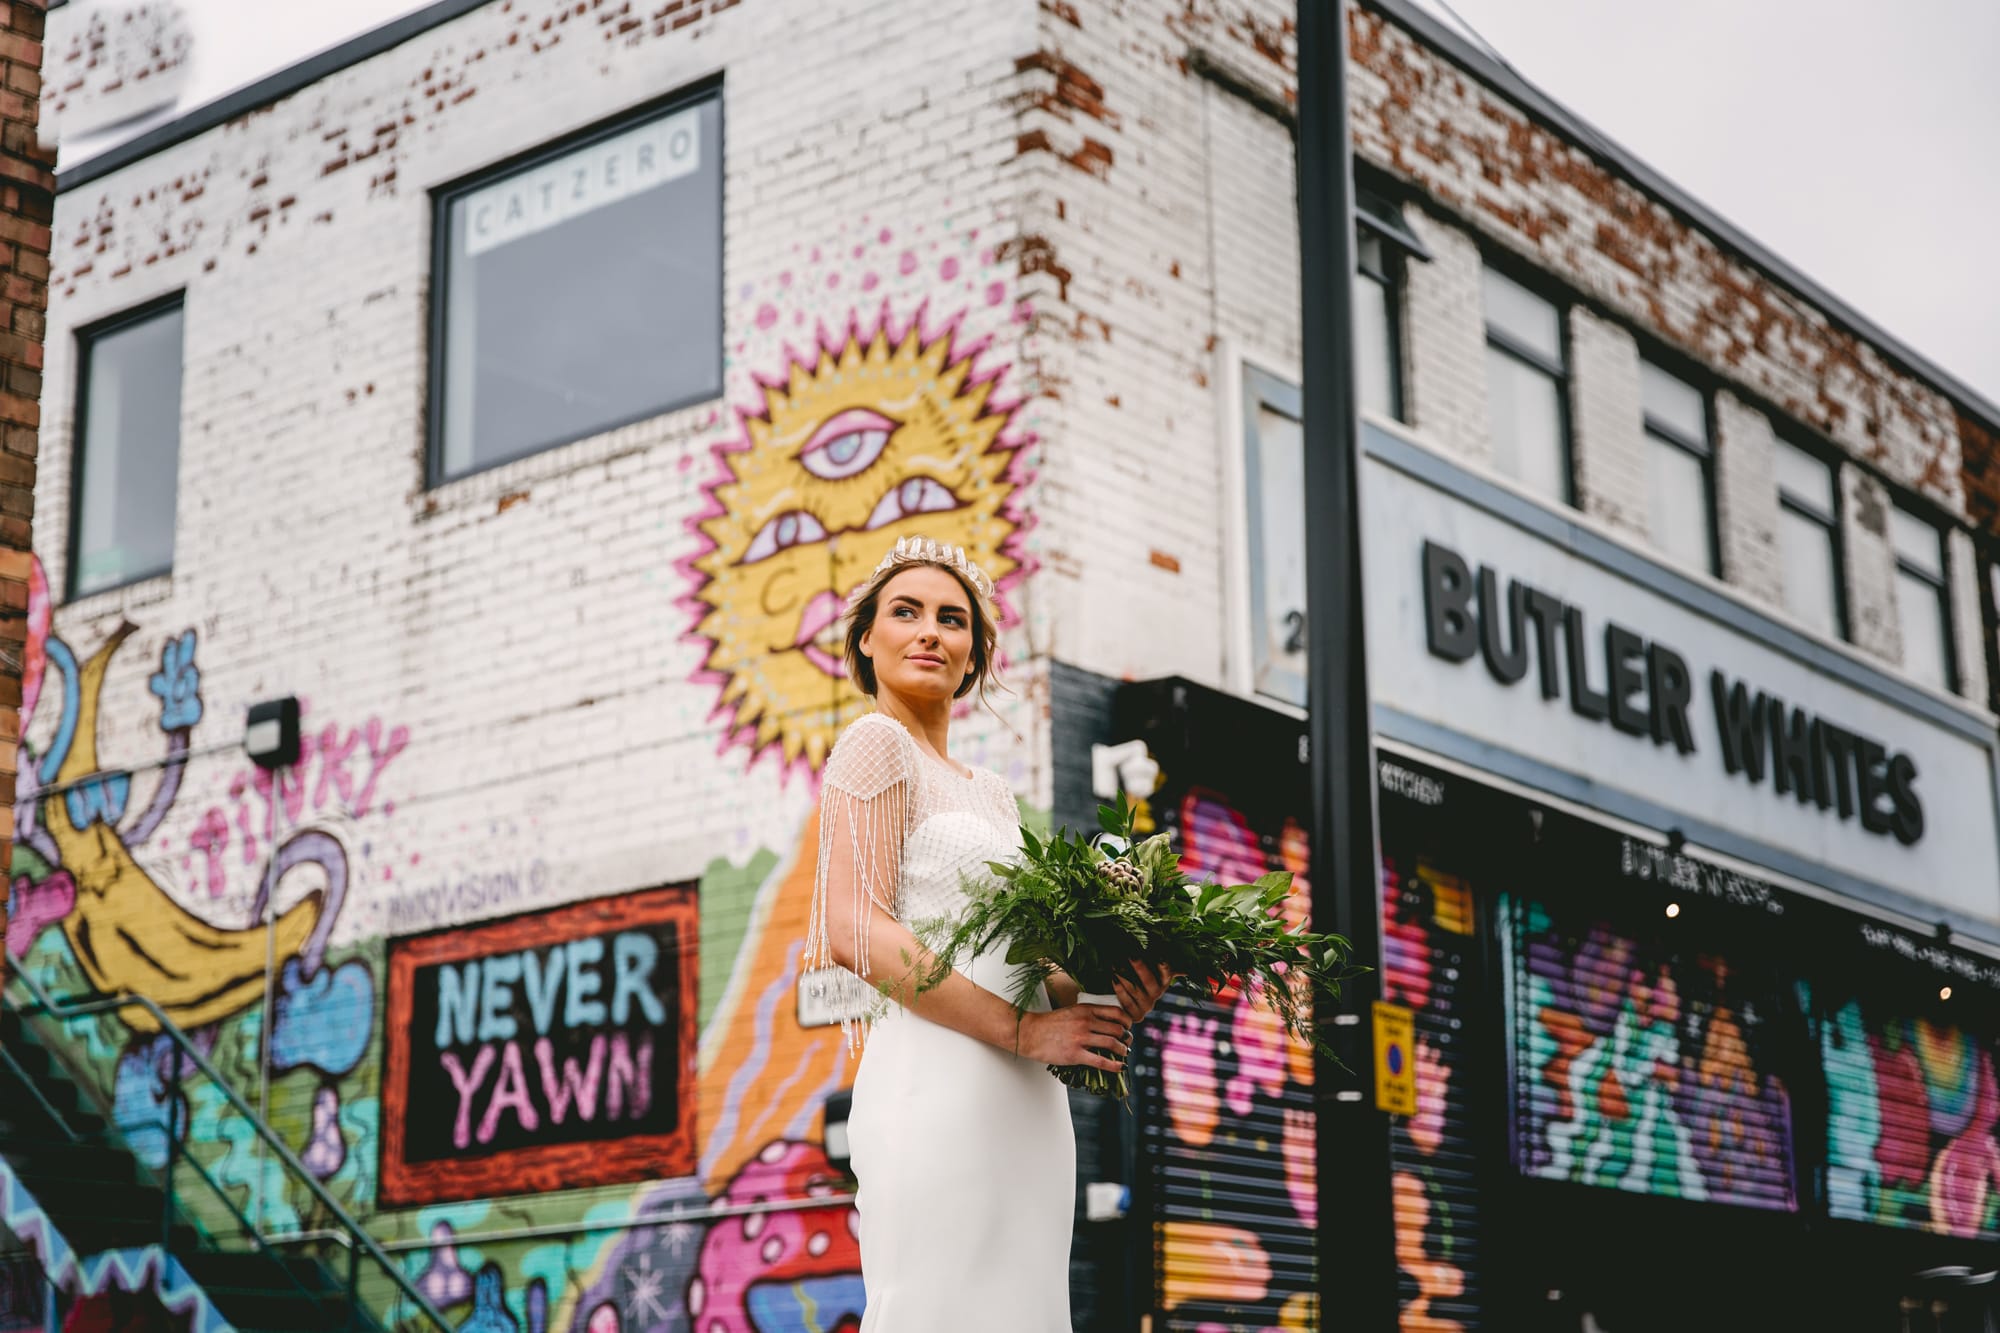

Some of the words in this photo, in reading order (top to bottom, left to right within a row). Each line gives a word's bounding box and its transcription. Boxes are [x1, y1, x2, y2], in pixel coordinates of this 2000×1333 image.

[475, 129, 692, 237] CATZERO
[1421, 538, 1697, 757] BUTLER
[1710, 666, 1926, 847] WHITES
[434, 931, 667, 1050] NEVER
[439, 1030, 654, 1150] YAWN
